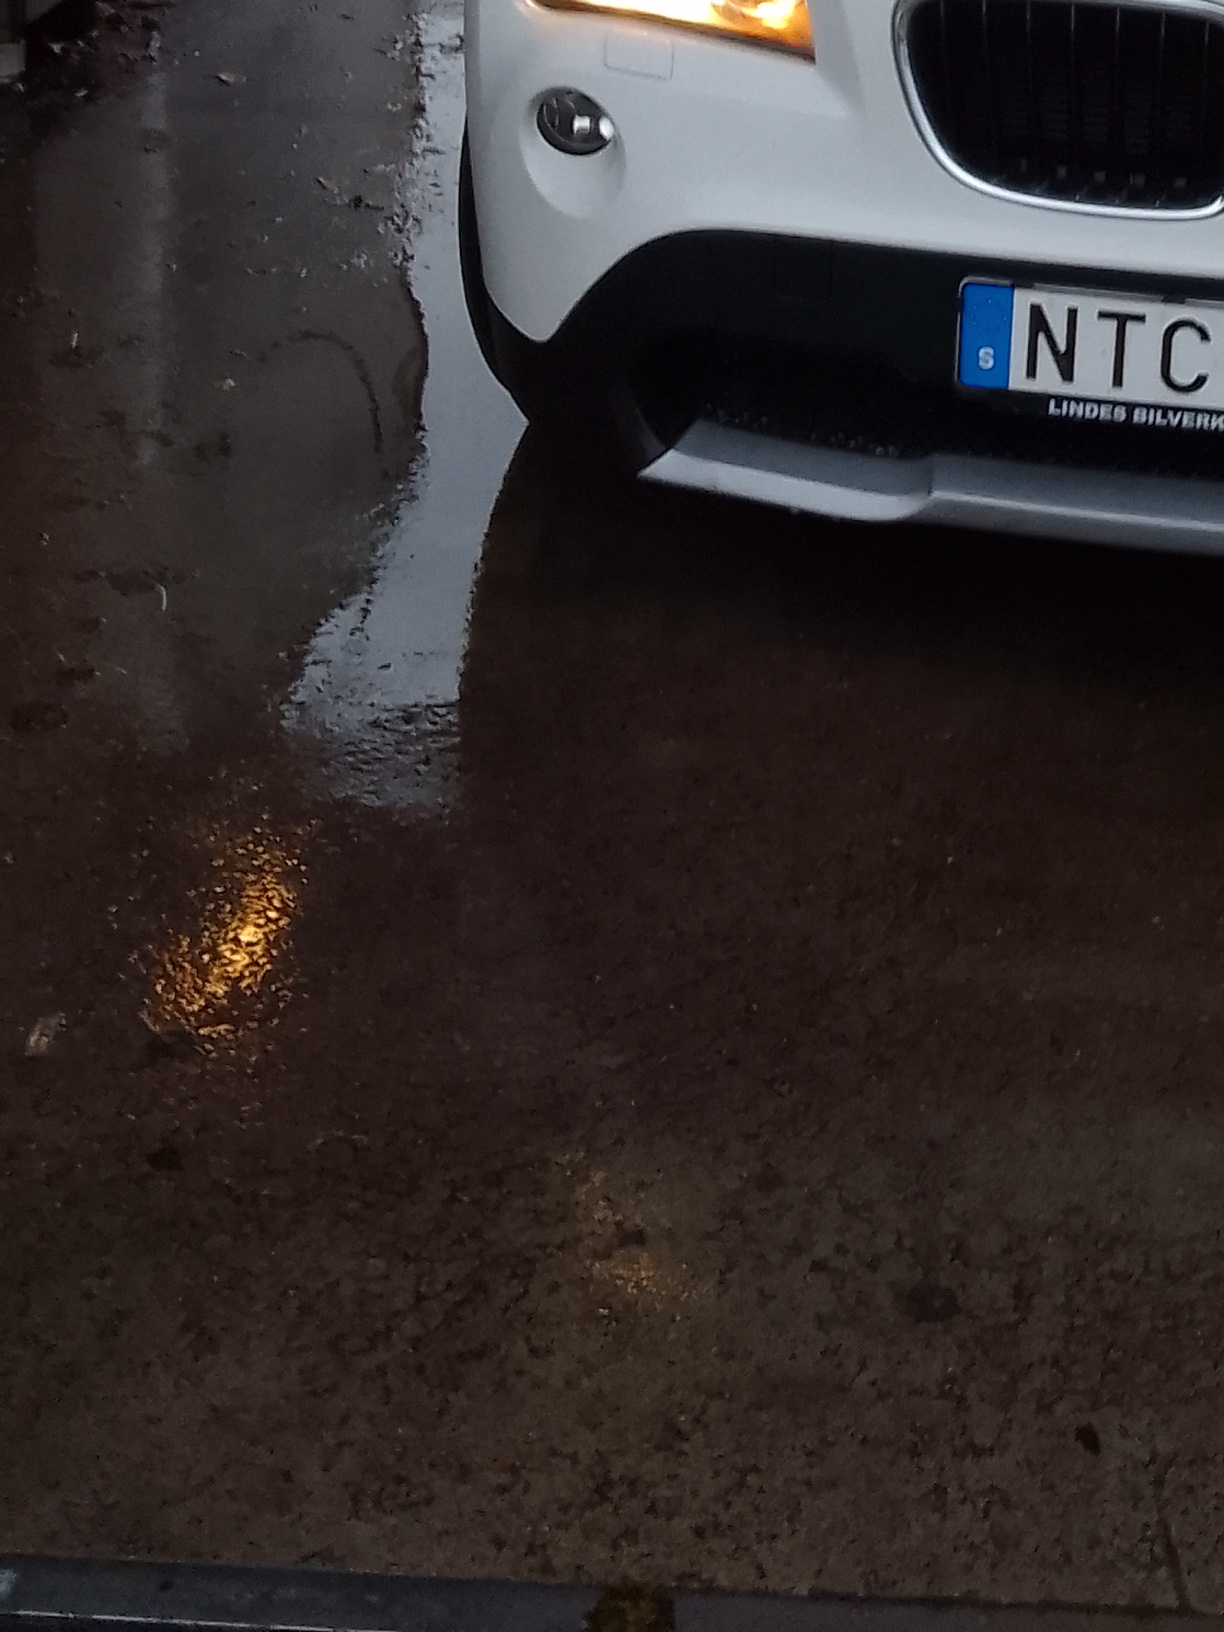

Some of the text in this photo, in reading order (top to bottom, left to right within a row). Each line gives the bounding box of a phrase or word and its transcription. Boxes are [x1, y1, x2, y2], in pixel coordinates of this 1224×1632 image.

[978, 346, 995, 369] S
[1026, 302, 1212, 394] NTC
[1048, 398, 1127, 423] LINDES
